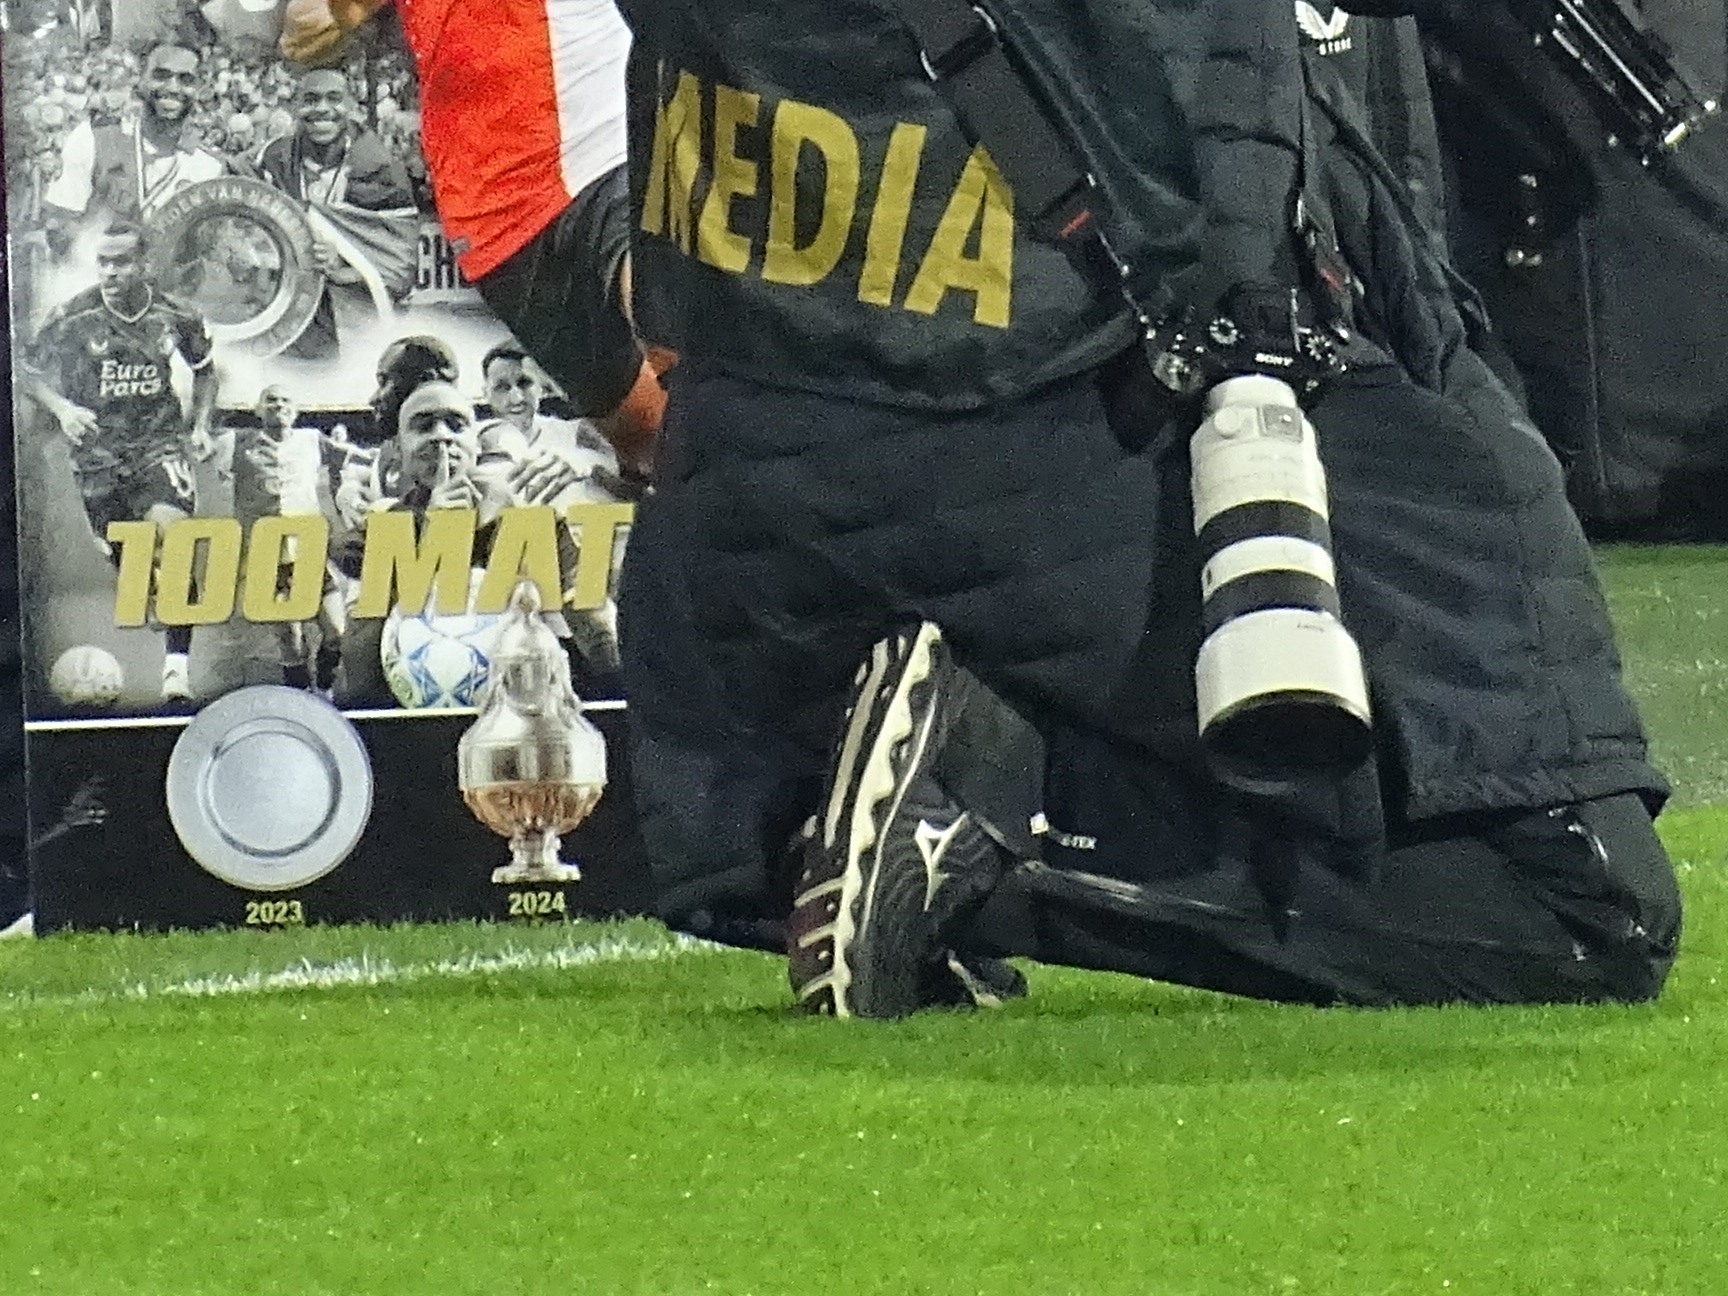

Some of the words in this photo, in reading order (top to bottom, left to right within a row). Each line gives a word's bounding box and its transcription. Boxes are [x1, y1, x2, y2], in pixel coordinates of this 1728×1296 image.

[640, 66, 1015, 329] MEDIA
[100, 359, 158, 380] Euro
[106, 517, 329, 629] 100
[245, 900, 304, 925] 2023
[508, 891, 566, 916] 2024
